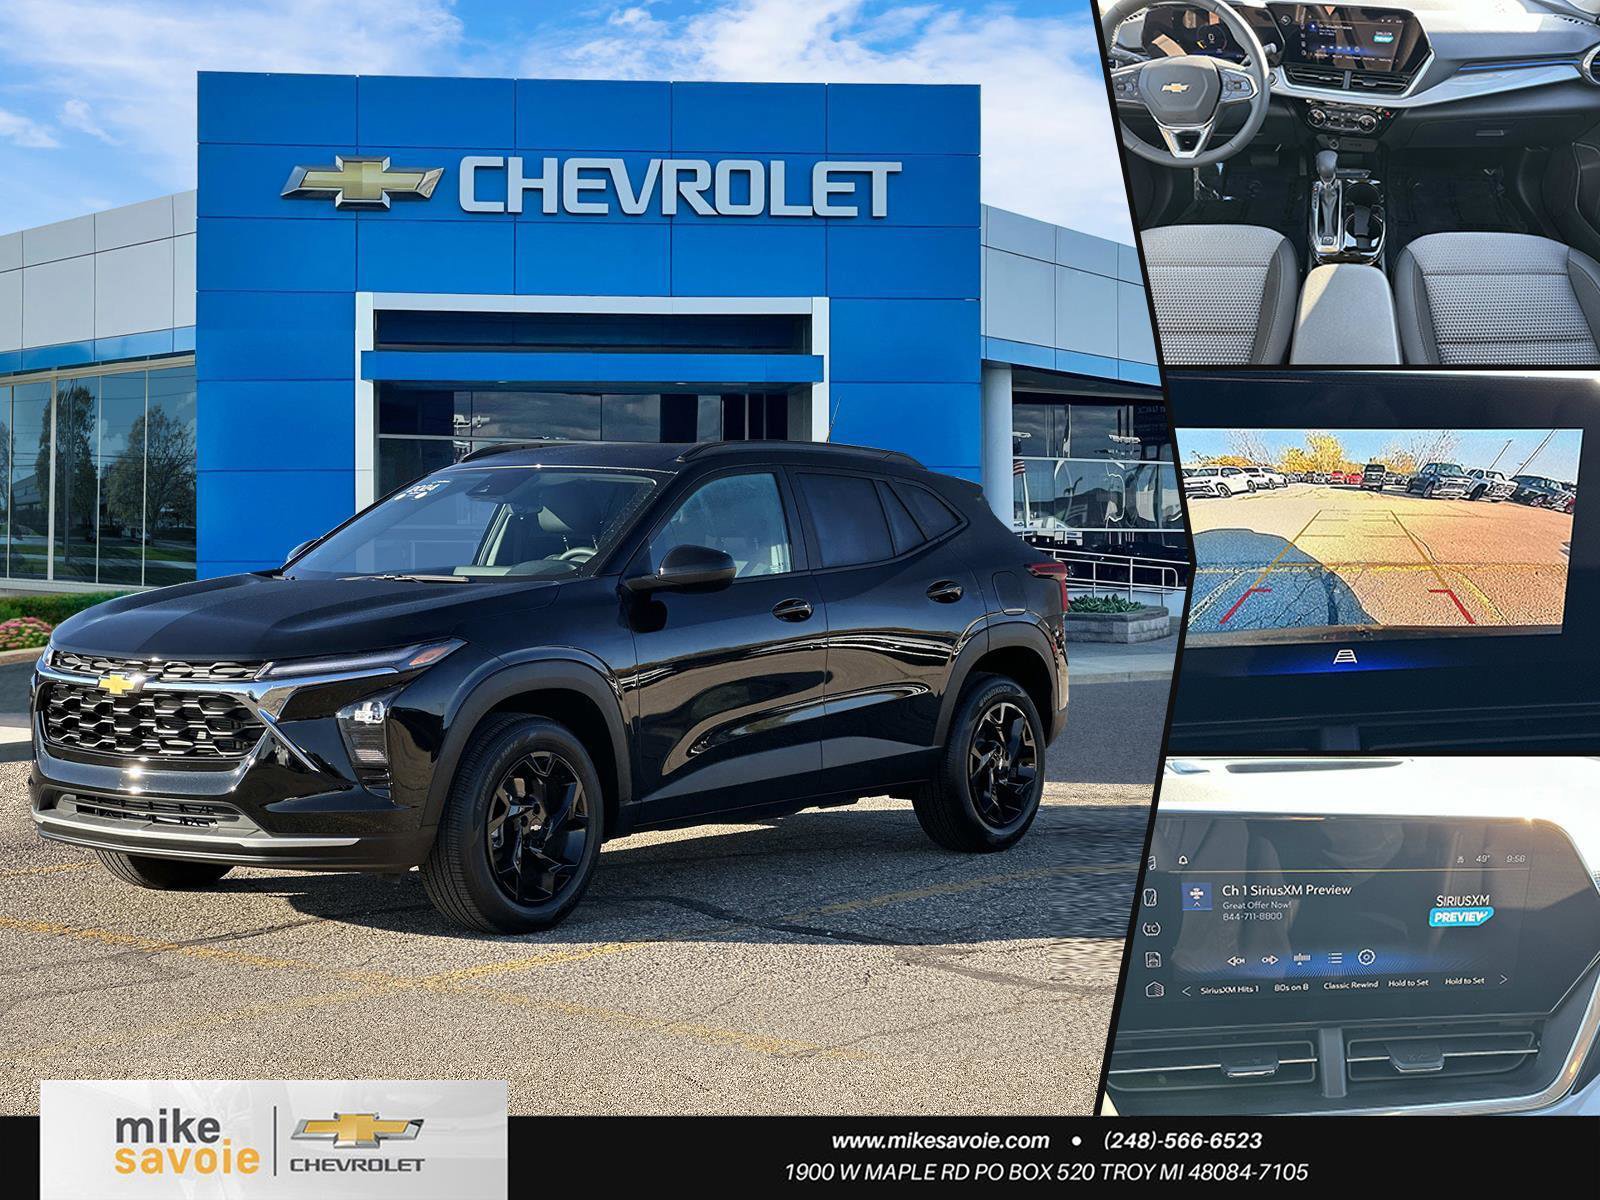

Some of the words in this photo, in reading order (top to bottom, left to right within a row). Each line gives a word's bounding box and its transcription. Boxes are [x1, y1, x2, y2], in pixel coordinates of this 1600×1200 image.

[459, 156, 902, 217] CHEVROLET
[1222, 885, 1240, 896] Ch
[1242, 885, 1247, 896] 1
[1250, 884, 1303, 897] SiriusXM
[1306, 885, 1352, 896] Preview
[1222, 901, 1246, 910] Great
[1247, 901, 1270, 910] Offer
[1436, 895, 1490, 907] SIRIUSXM
[1222, 912, 1283, 921] 844-711-8800
[1434, 911, 1488, 923] PREVIEW
[1323, 982, 1350, 990] Classic
[1351, 981, 1379, 989] Rewind
[1388, 979, 1406, 988] Hold
[1416, 979, 1430, 987] Set
[1444, 977, 1463, 985] Hold
[1472, 977, 1485, 985] Set
[1200, 986, 1237, 995] SiriusXM
